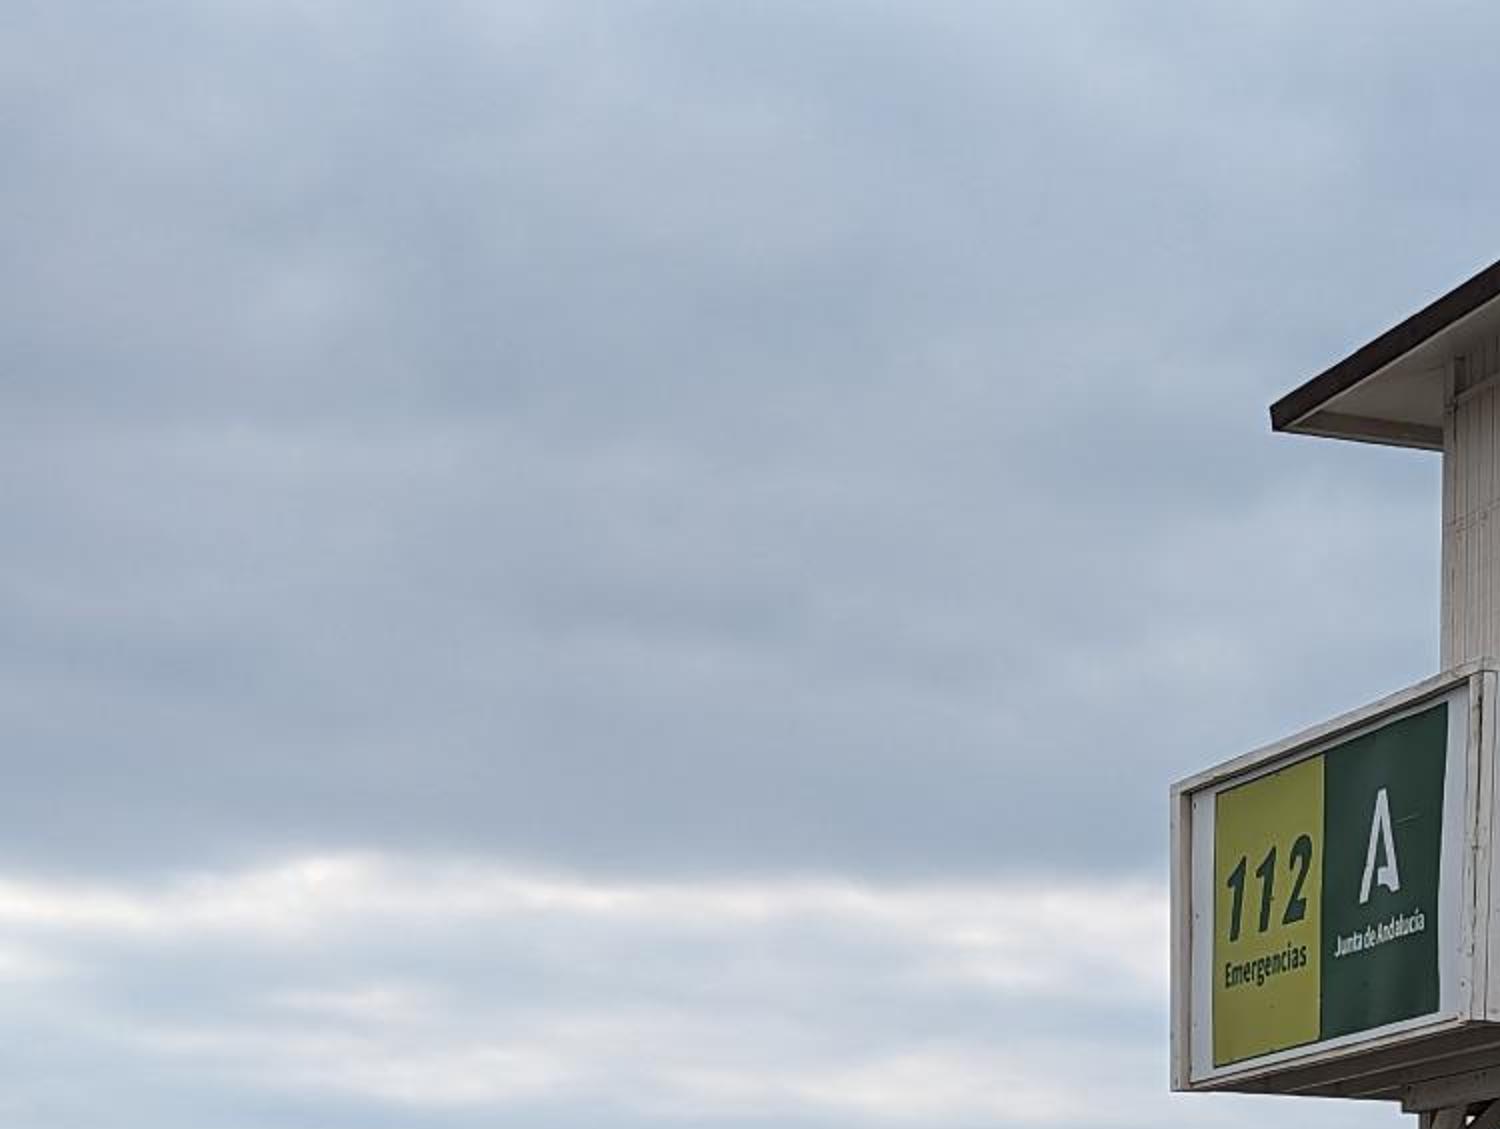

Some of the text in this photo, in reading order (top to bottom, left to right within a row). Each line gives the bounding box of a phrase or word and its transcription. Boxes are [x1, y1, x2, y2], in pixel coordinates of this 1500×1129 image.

[1226, 834, 1313, 942] 112
[1334, 908, 1425, 957] Junta de Andalucía
[1225, 942, 1307, 989] Emergencias
